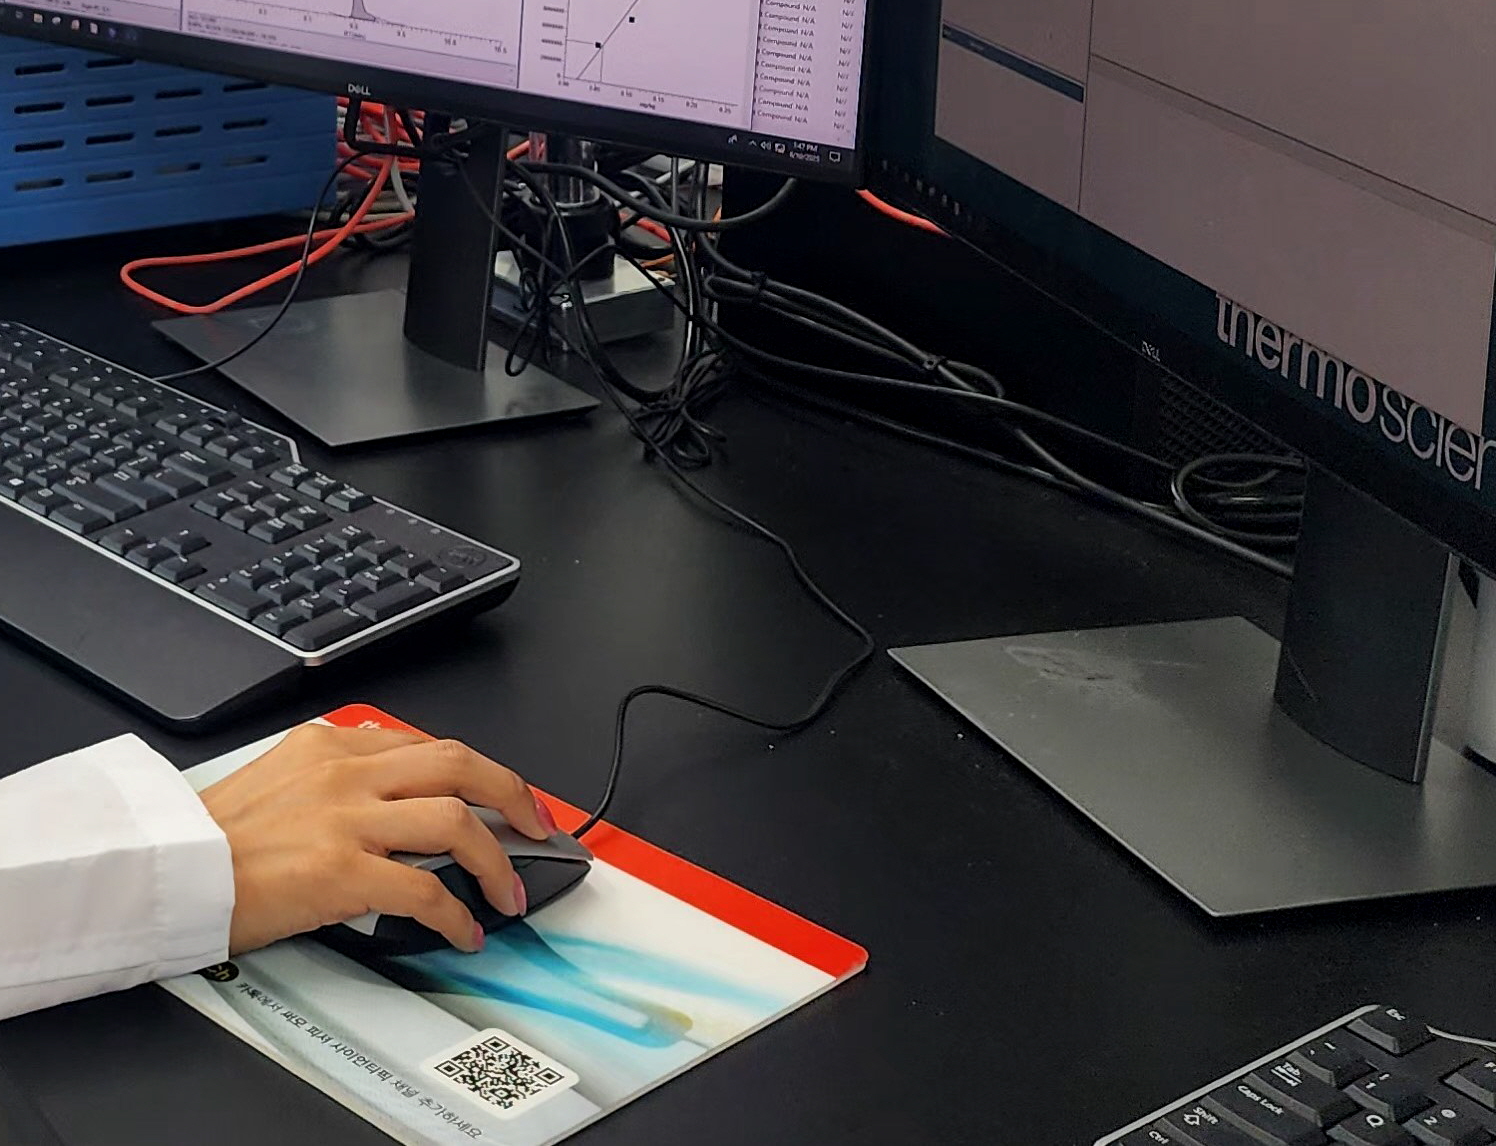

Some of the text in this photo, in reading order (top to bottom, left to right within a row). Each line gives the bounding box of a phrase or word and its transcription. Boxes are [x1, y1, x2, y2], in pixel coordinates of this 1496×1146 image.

[347, 83, 371, 97] DELL
[757, 109, 792, 122] Compound
[794, 116, 808, 124] N/A
[806, 143, 819, 152] PM
[1385, 1008, 1406, 1021] Esc
[236, 982, 482, 1139] 카톡에서 써모 피셔 사이언티픽 채널 추가하세요
[1282, 1062, 1301, 1076] Tab
[1237, 1085, 1285, 1116] Caps Lock
[1193, 1106, 1220, 1125] Shift
[1366, 1114, 1384, 1128] Q
[1424, 1116, 1438, 1126] 2
[1148, 1130, 1170, 1146] Ctrl
